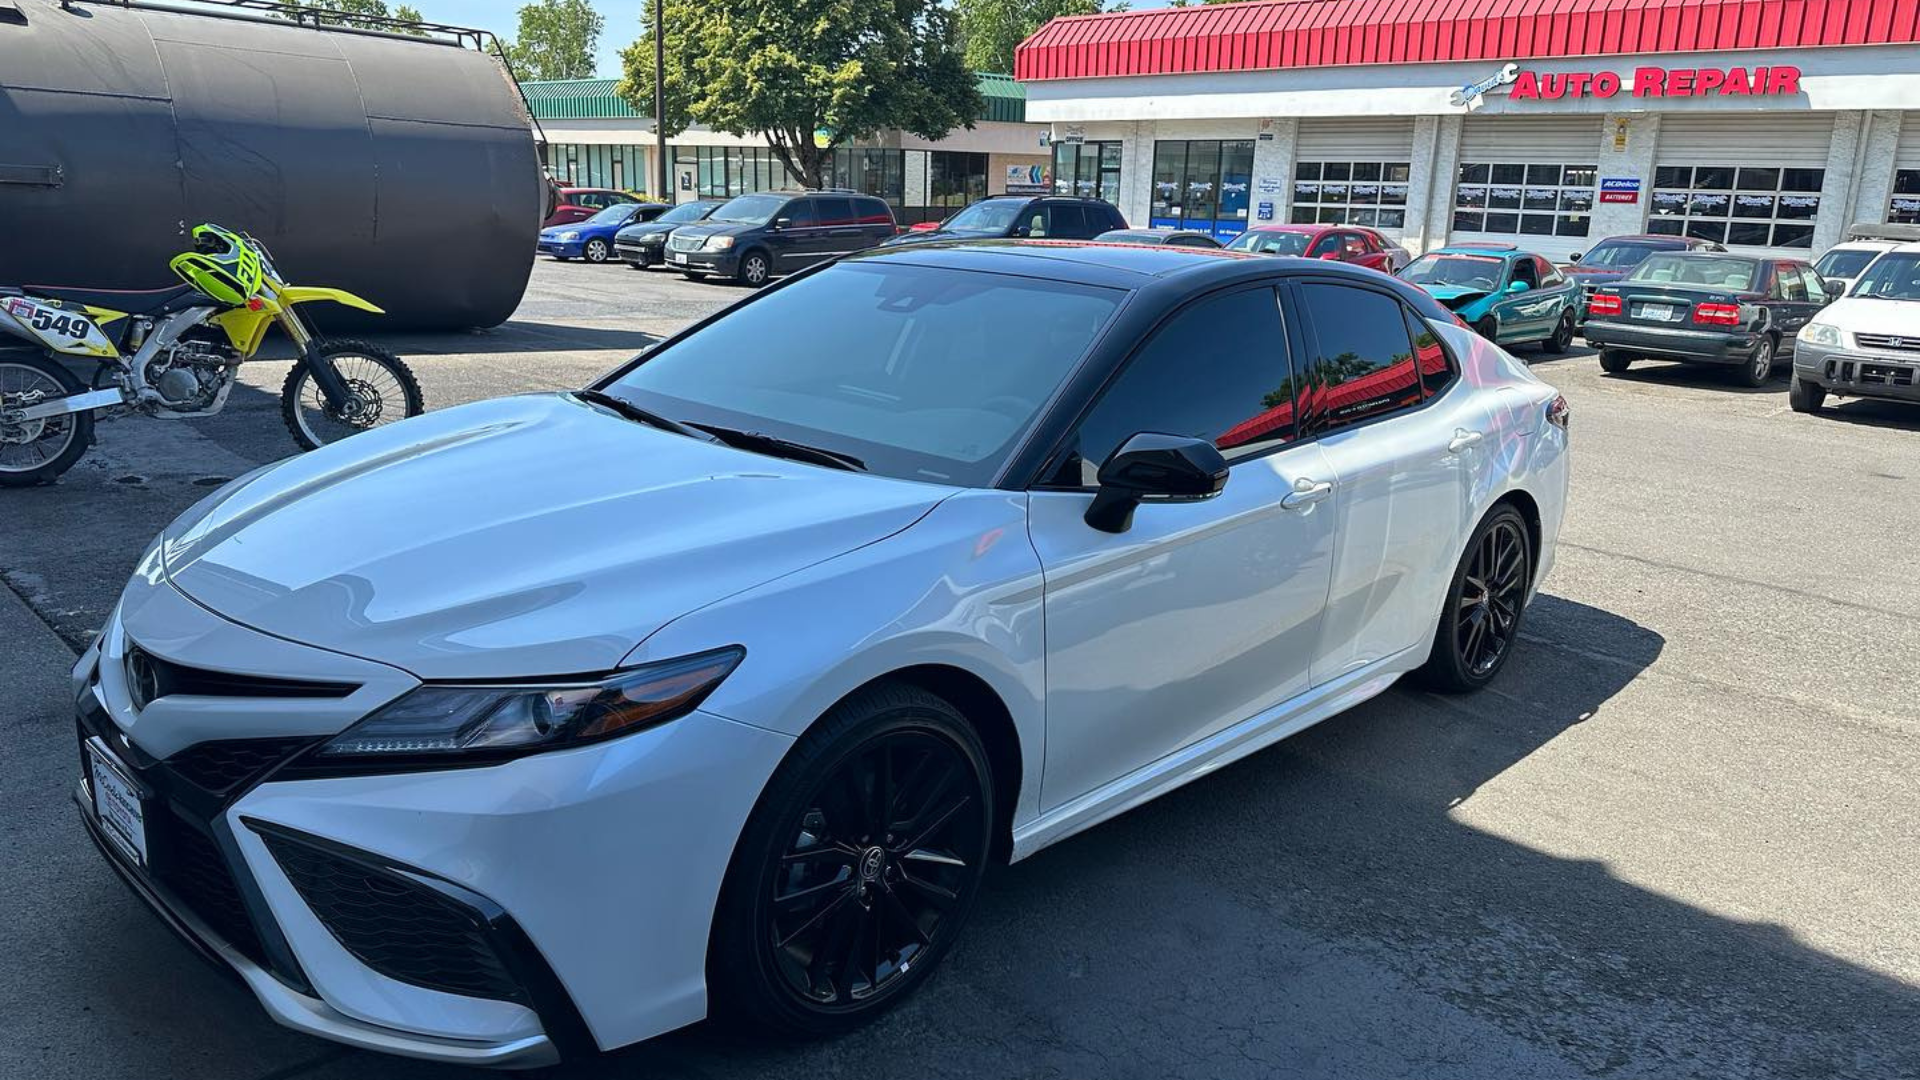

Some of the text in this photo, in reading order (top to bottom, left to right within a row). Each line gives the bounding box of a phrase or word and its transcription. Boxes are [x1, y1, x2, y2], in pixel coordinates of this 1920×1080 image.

[1509, 66, 1801, 100] AUTO REPAIR
[32, 308, 90, 339] 549
